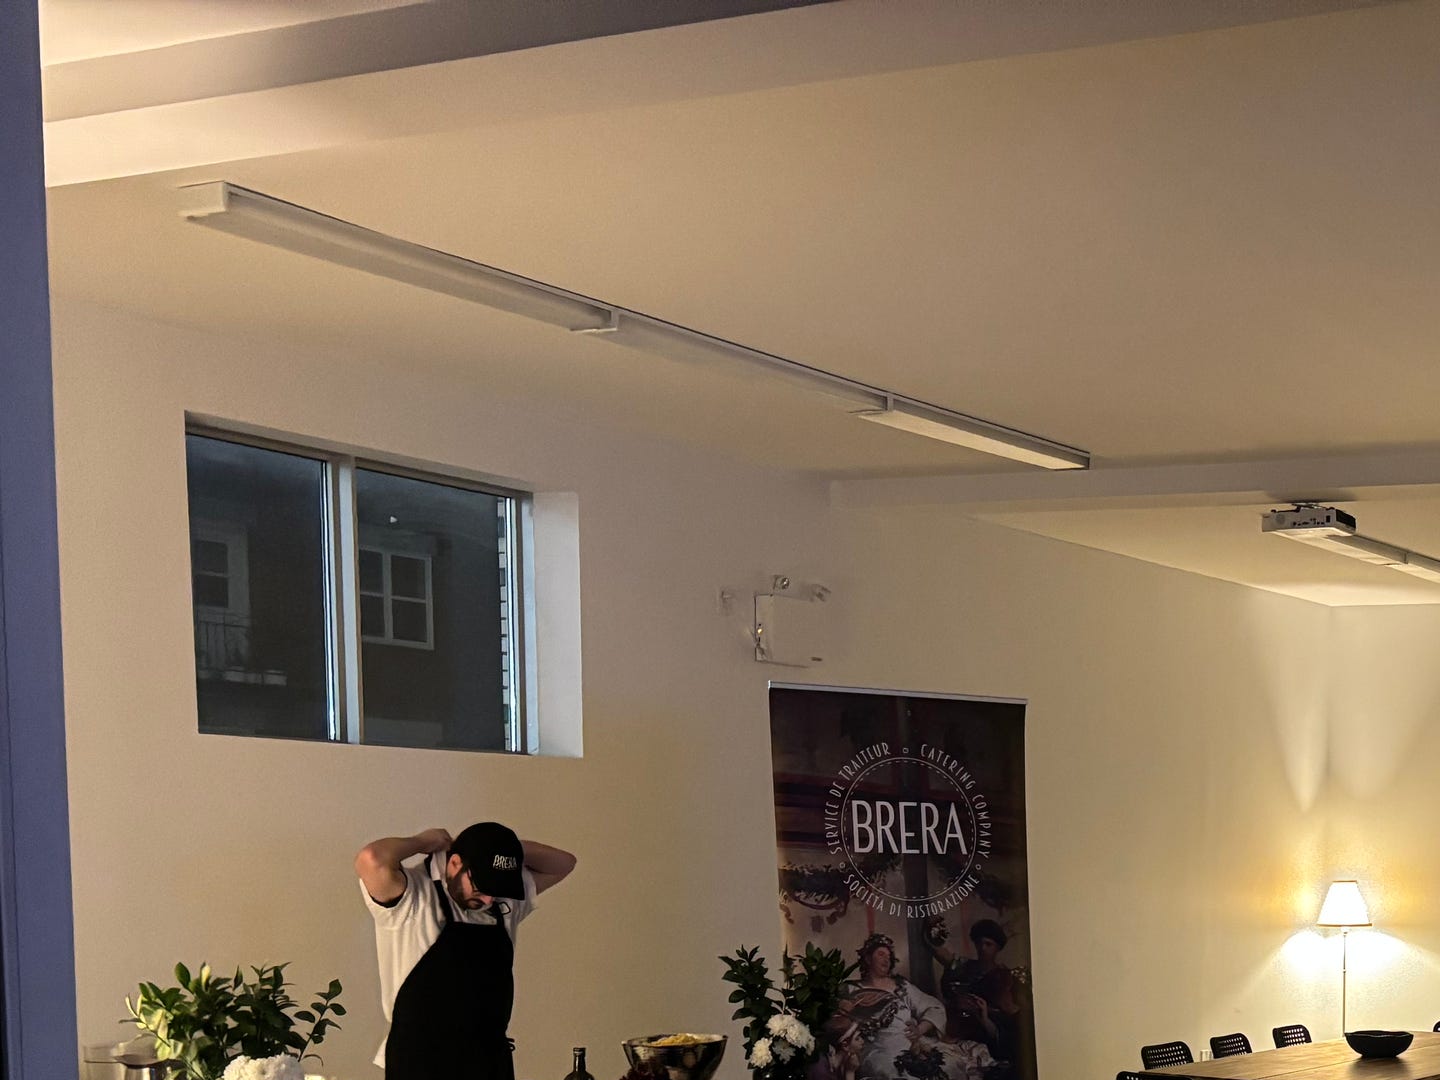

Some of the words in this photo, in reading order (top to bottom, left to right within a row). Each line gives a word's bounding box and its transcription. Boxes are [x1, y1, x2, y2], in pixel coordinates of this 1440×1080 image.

[838, 742, 891, 780] TRAITEUR
[829, 781, 845, 798] DE
[920, 743, 976, 790] CATERING
[972, 794, 992, 859] COMPANY
[825, 802, 842, 855] SERVICE
[851, 800, 968, 855] BRERA
[889, 903, 901, 917] DI
[907, 874, 980, 919] RISTORAZIONE
